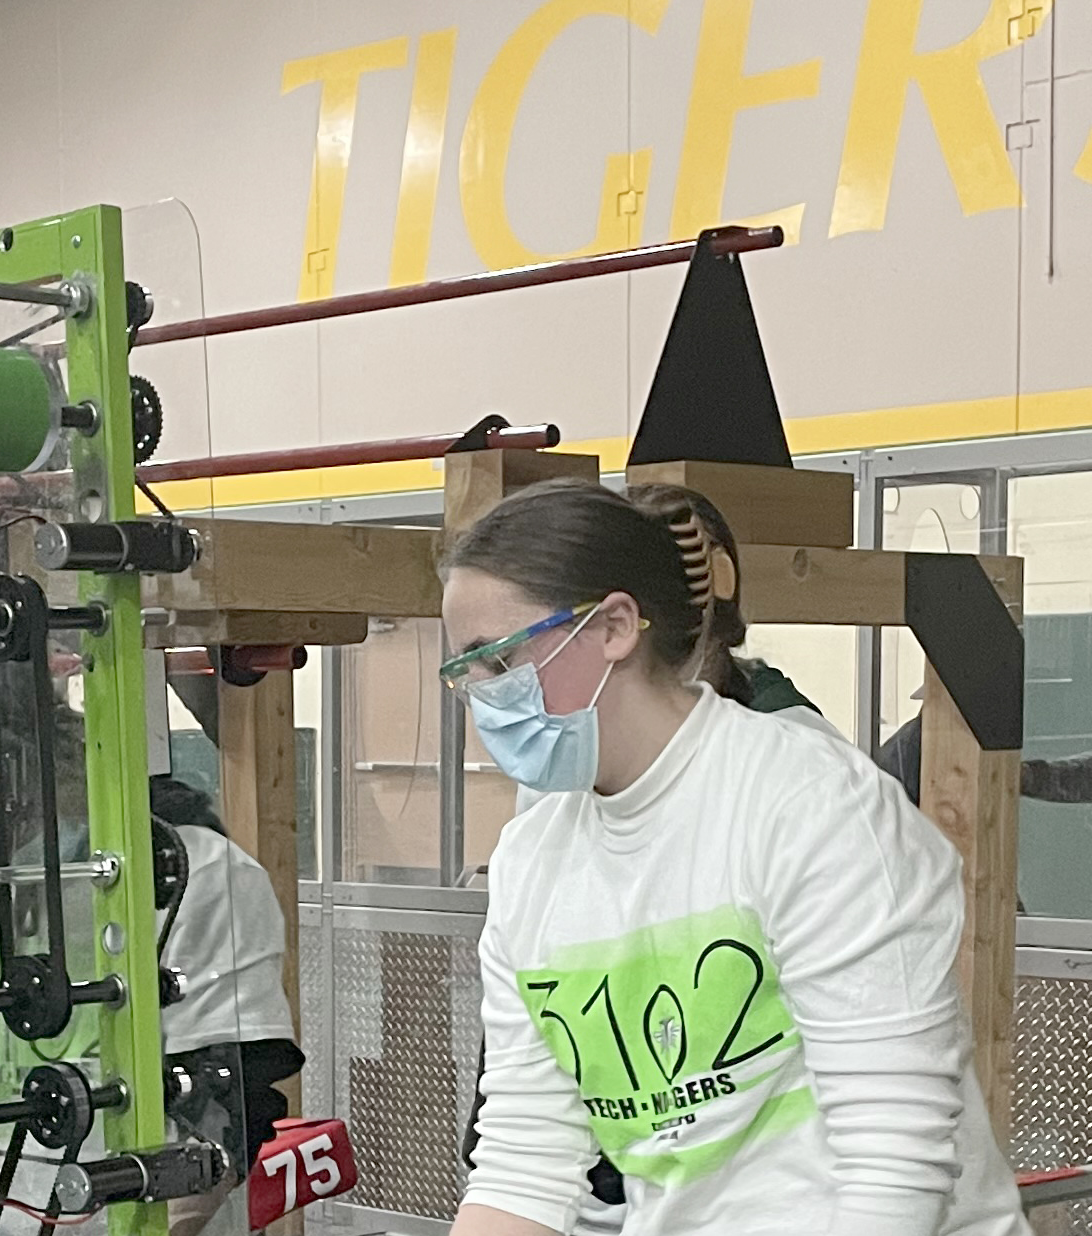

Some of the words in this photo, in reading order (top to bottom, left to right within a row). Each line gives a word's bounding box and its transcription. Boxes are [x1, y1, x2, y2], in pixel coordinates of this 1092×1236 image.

[280, 0, 1092, 303] TIGER
[526, 938, 785, 1091] 3102
[261, 1132, 343, 1215] 75
